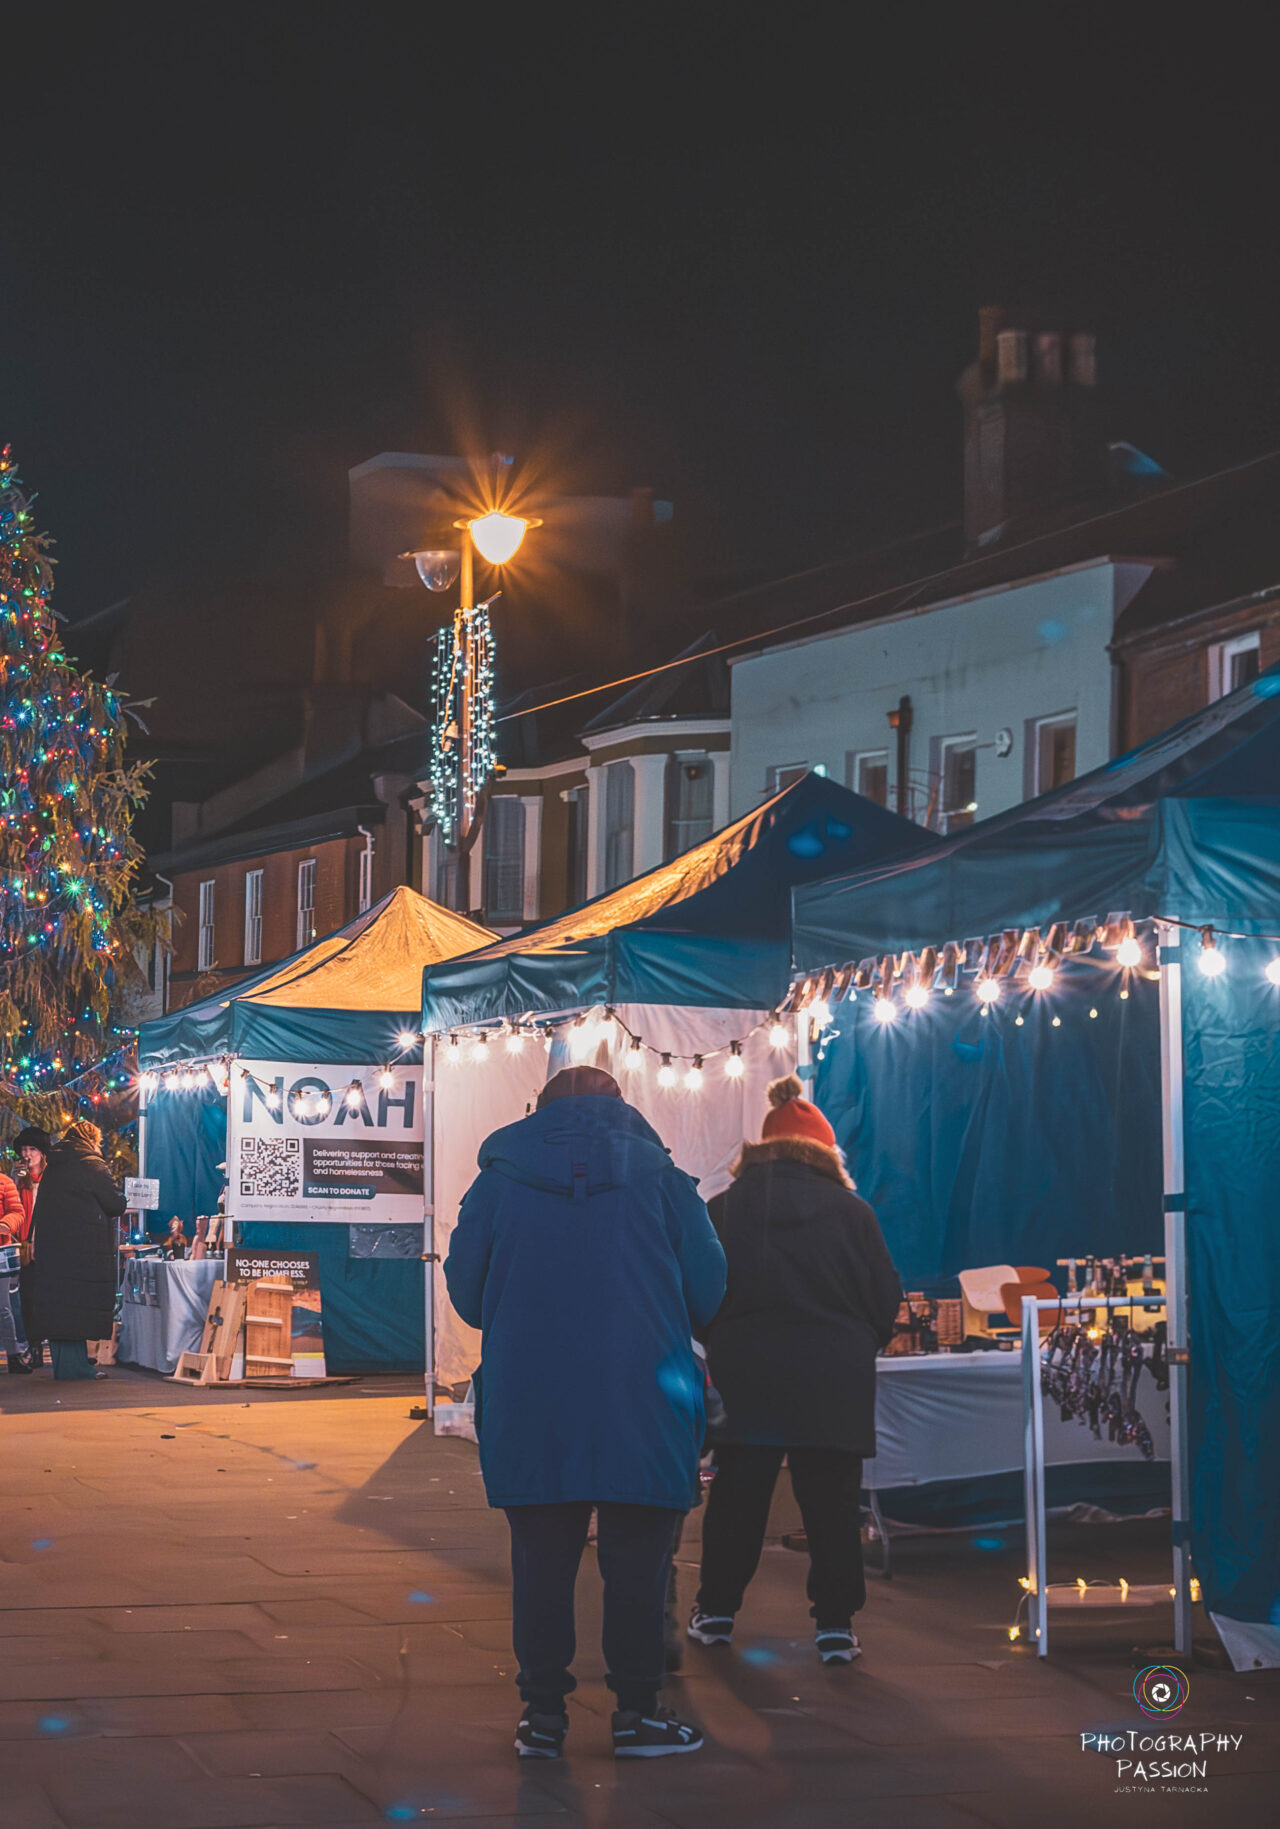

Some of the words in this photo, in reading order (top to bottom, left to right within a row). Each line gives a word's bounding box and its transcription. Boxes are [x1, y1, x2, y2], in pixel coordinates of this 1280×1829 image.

[242, 1076, 416, 1129] NOAH
[312, 1149, 350, 1159] Delivering
[351, 1151, 380, 1160] support
[381, 1152, 396, 1160] and
[397, 1153, 424, 1161] creatin
[313, 1159, 362, 1170] opportunities
[363, 1160, 374, 1168] for
[375, 1160, 395, 1169] those
[396, 1162, 420, 1171] facing
[329, 1168, 384, 1177] homelessness
[308, 1187, 328, 1195] SCAN
[340, 1188, 370, 1196] DONATE
[235, 1259, 269, 1268] NO-ONE
[270, 1260, 310, 1269] CHOOSES
[239, 1268, 251, 1277] TO
[252, 1269, 261, 1277] BE
